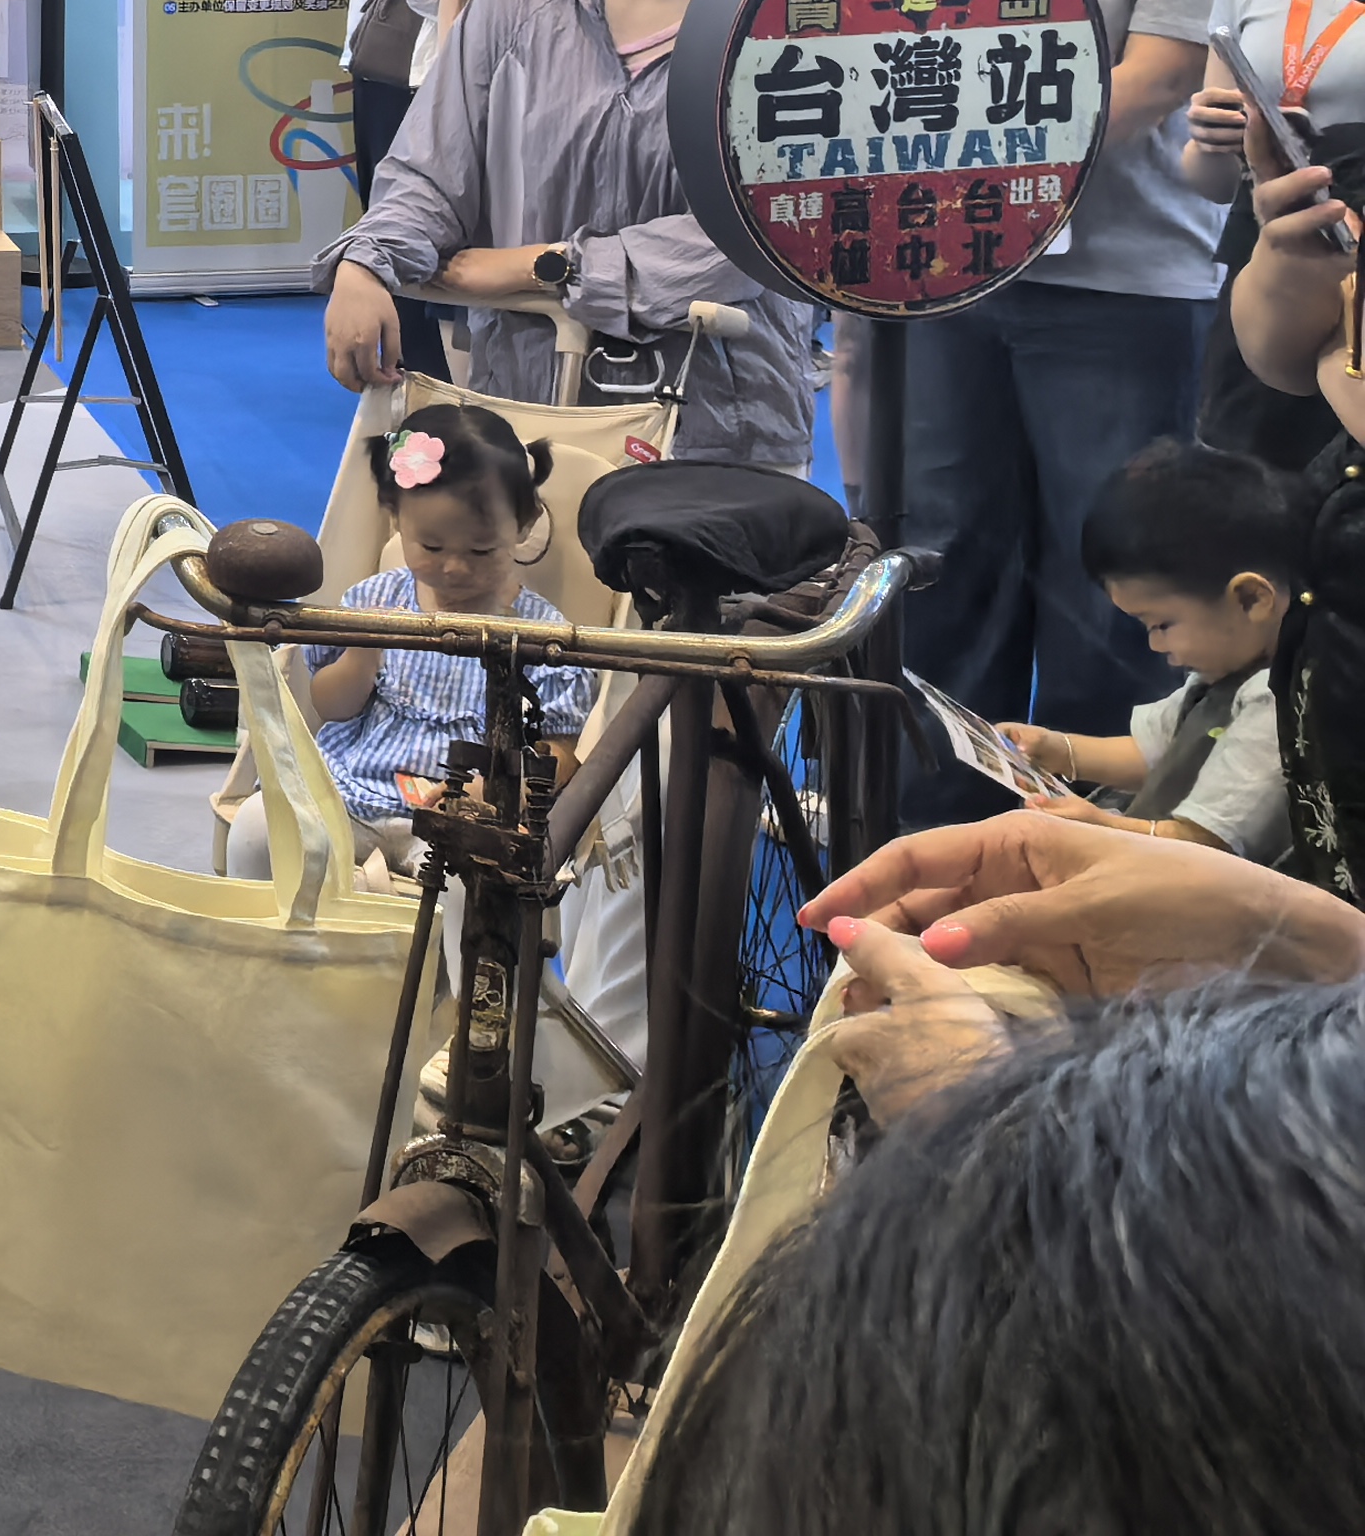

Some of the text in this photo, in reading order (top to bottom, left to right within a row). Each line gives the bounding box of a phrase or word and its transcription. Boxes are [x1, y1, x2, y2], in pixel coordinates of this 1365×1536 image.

[754, 30, 1079, 143] 台灣站
[777, 126, 1048, 181] TAIWAN
[157, 175, 289, 233] 套圈圈
[896, 181, 938, 281] 台中
[963, 177, 1004, 277] 台北
